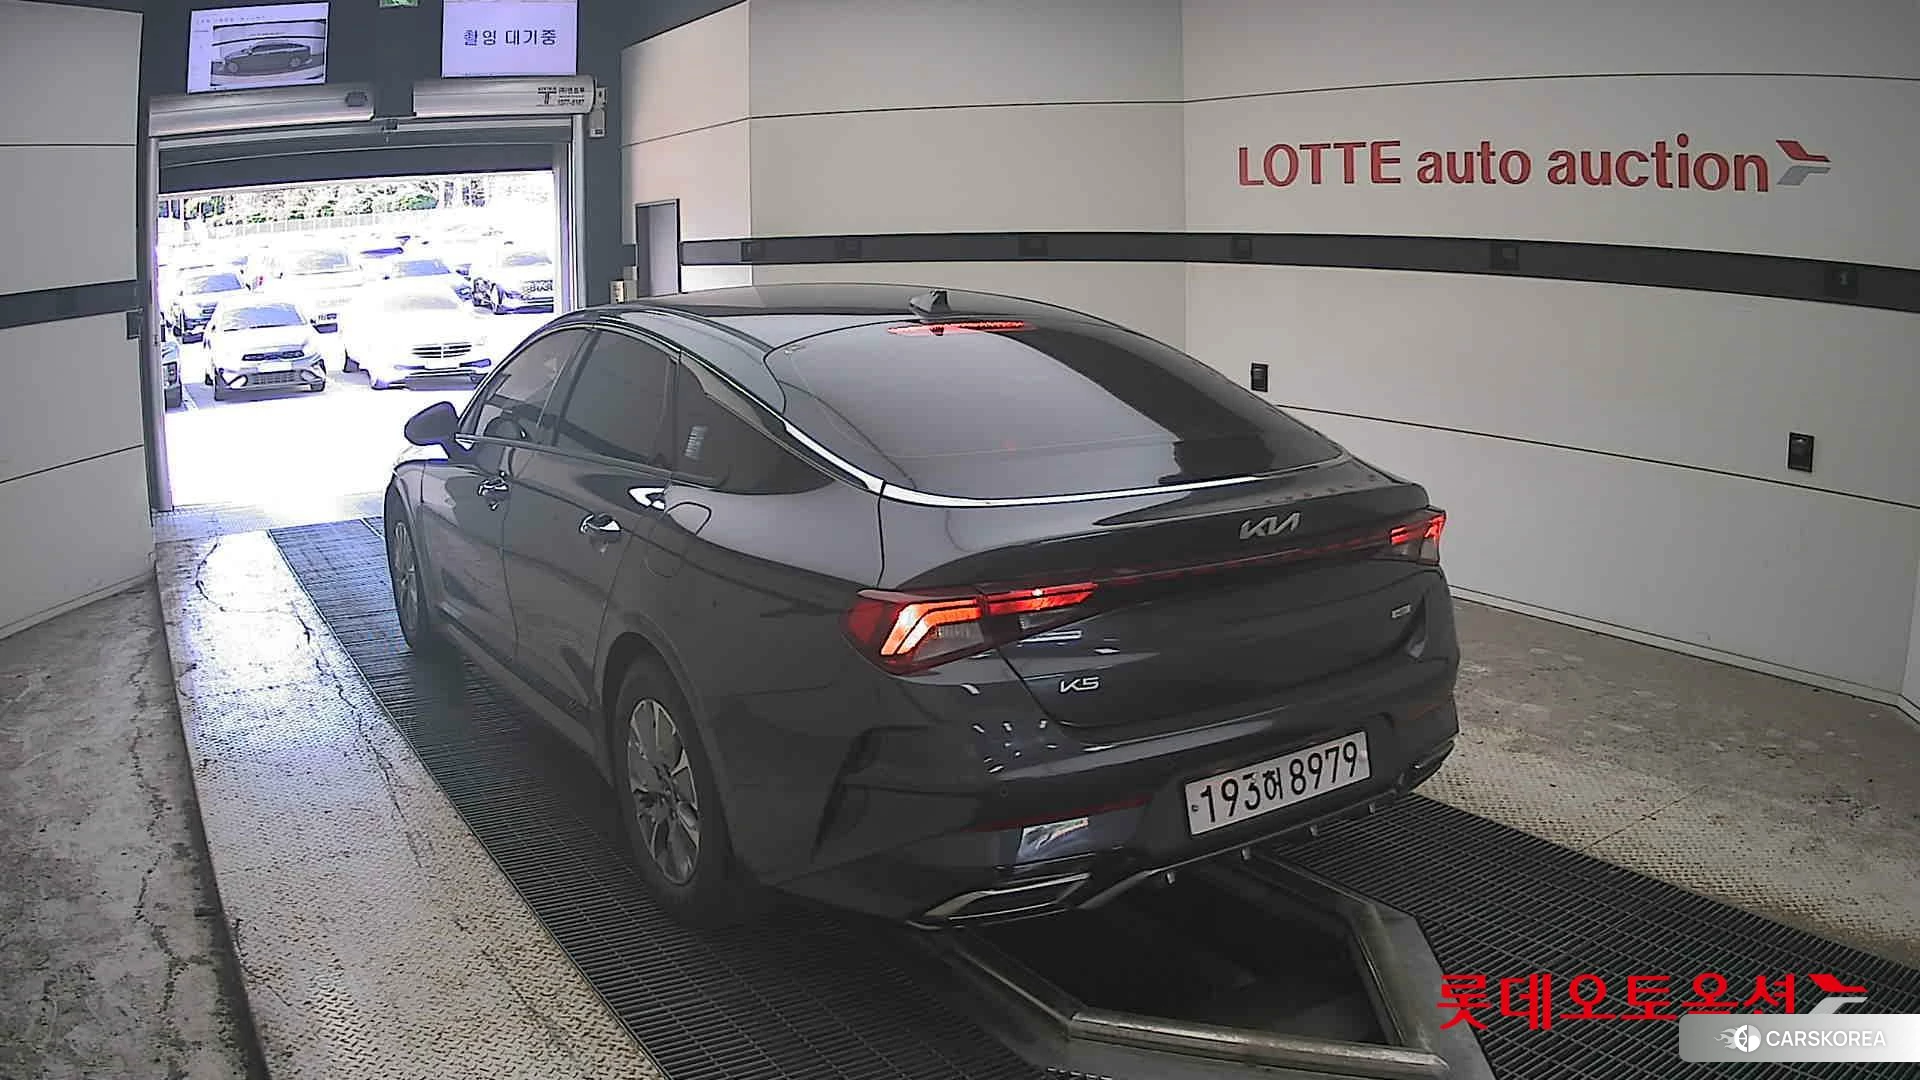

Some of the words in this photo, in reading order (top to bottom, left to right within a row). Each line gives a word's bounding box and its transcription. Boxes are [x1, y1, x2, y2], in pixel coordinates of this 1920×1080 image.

[505, 29, 557, 46] 대기중
[1239, 140, 1401, 187] LOTTE
[1416, 141, 1532, 185] auto
[1547, 133, 1769, 193] auction
[1060, 677, 1100, 693] K5
[1289, 741, 1357, 795] 8979
